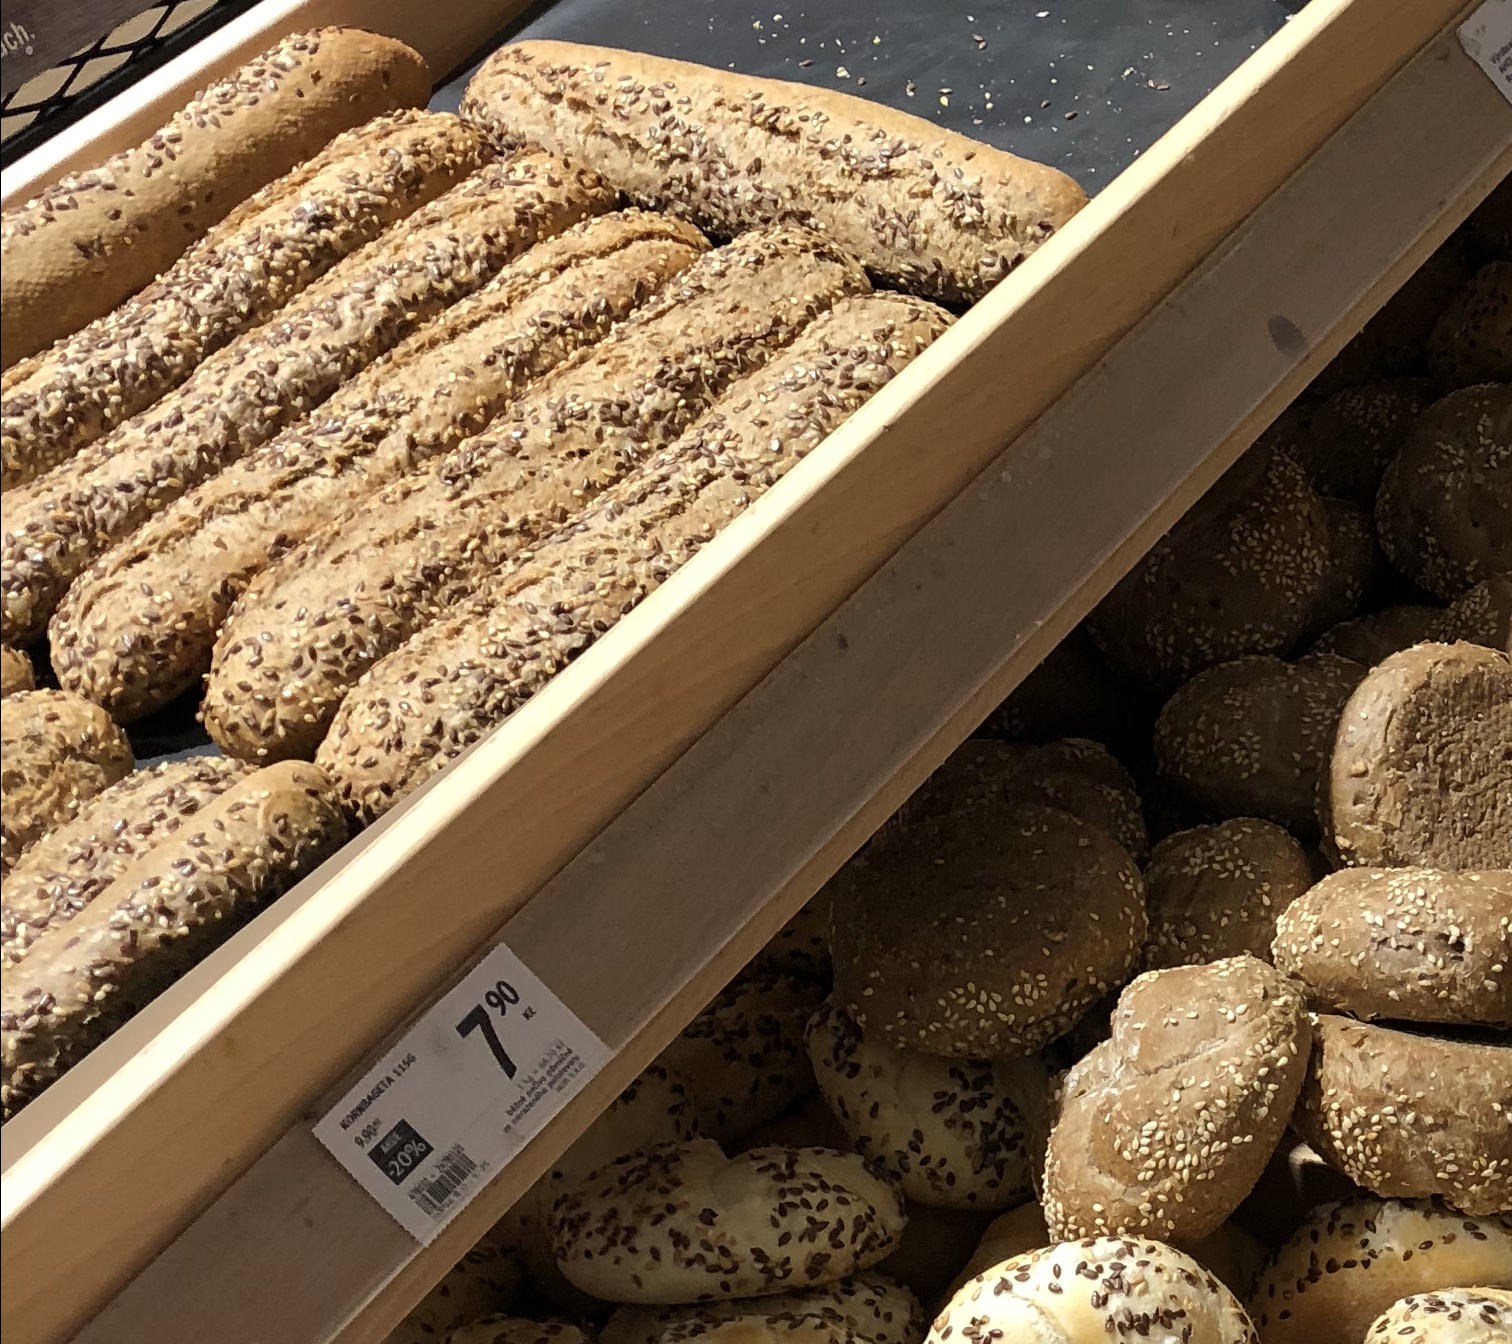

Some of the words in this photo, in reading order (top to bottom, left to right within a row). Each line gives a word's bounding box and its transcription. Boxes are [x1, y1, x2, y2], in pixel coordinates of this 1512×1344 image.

[484, 980, 520, 1016] 90
[522, 1006, 536, 1021] Kč
[455, 1003, 517, 1080] 7
[339, 1075, 395, 1131] KORNBAGETA
[392, 1052, 417, 1077] 115G
[388, 1139, 427, 1177] -20%
